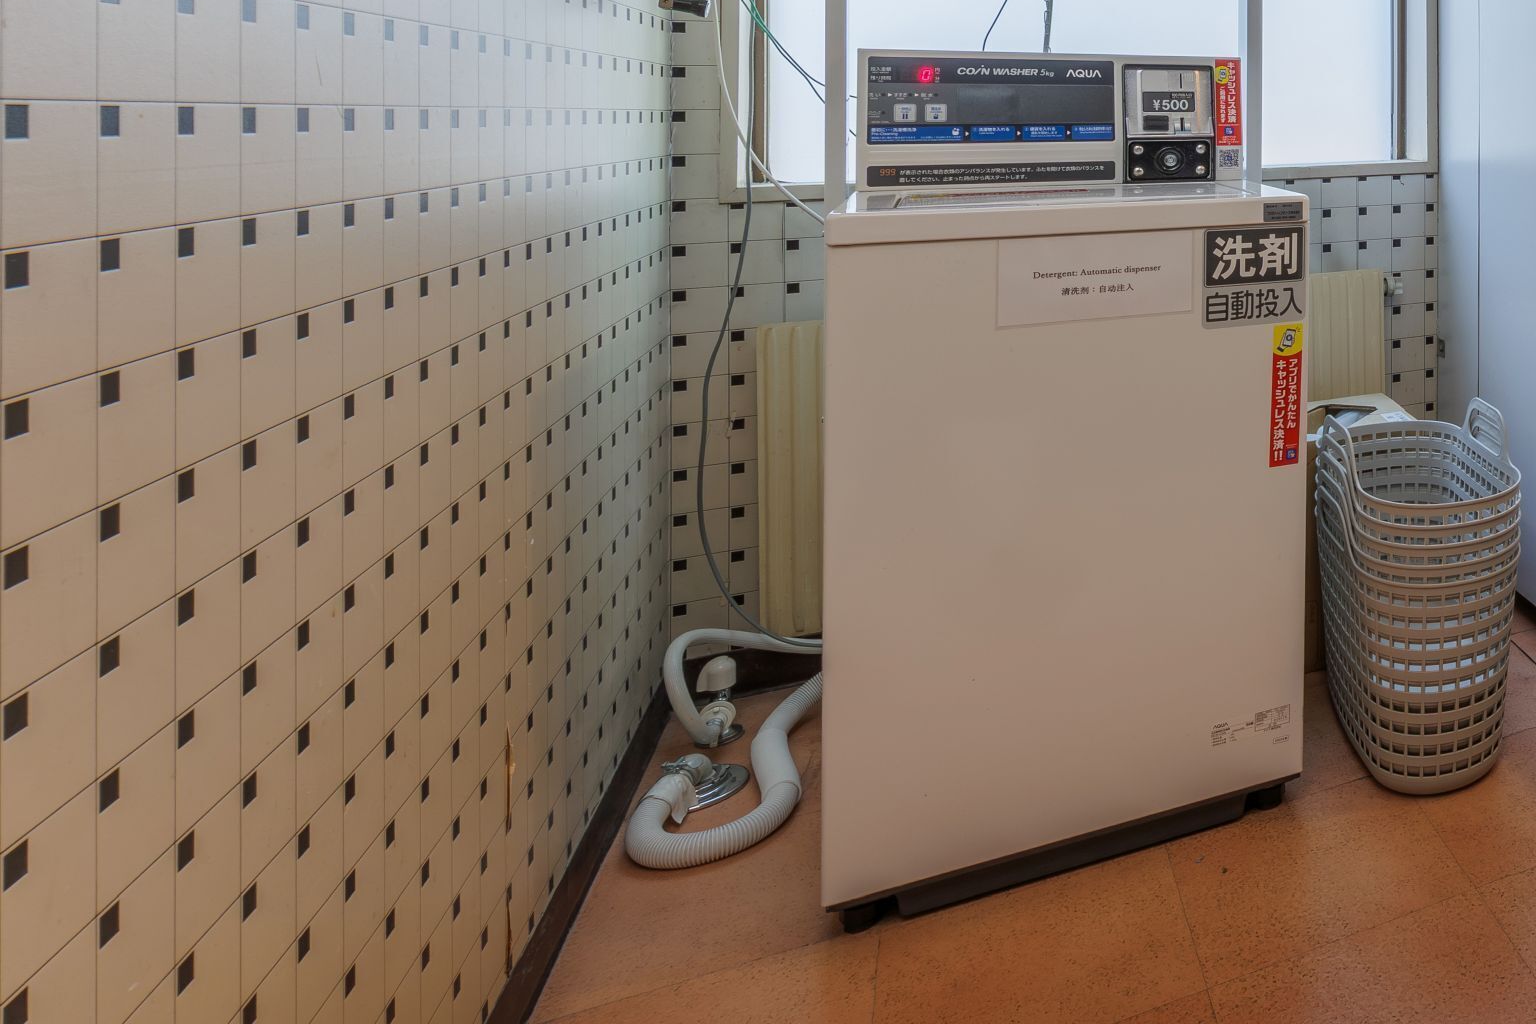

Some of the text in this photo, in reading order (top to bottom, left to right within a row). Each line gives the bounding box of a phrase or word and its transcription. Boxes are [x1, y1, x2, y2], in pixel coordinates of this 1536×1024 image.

[992, 68, 1038, 76] WASHER
[1066, 69, 1102, 78] AQUA
[1153, 99, 1189, 111] ¥500
[1212, 233, 1298, 280] 洗剤
[1080, 266, 1122, 276] Automatic
[1124, 264, 1162, 275] dispenser
[1206, 288, 1303, 323] 自動投入
[1286, 358, 1298, 429] アプリでかんたん
